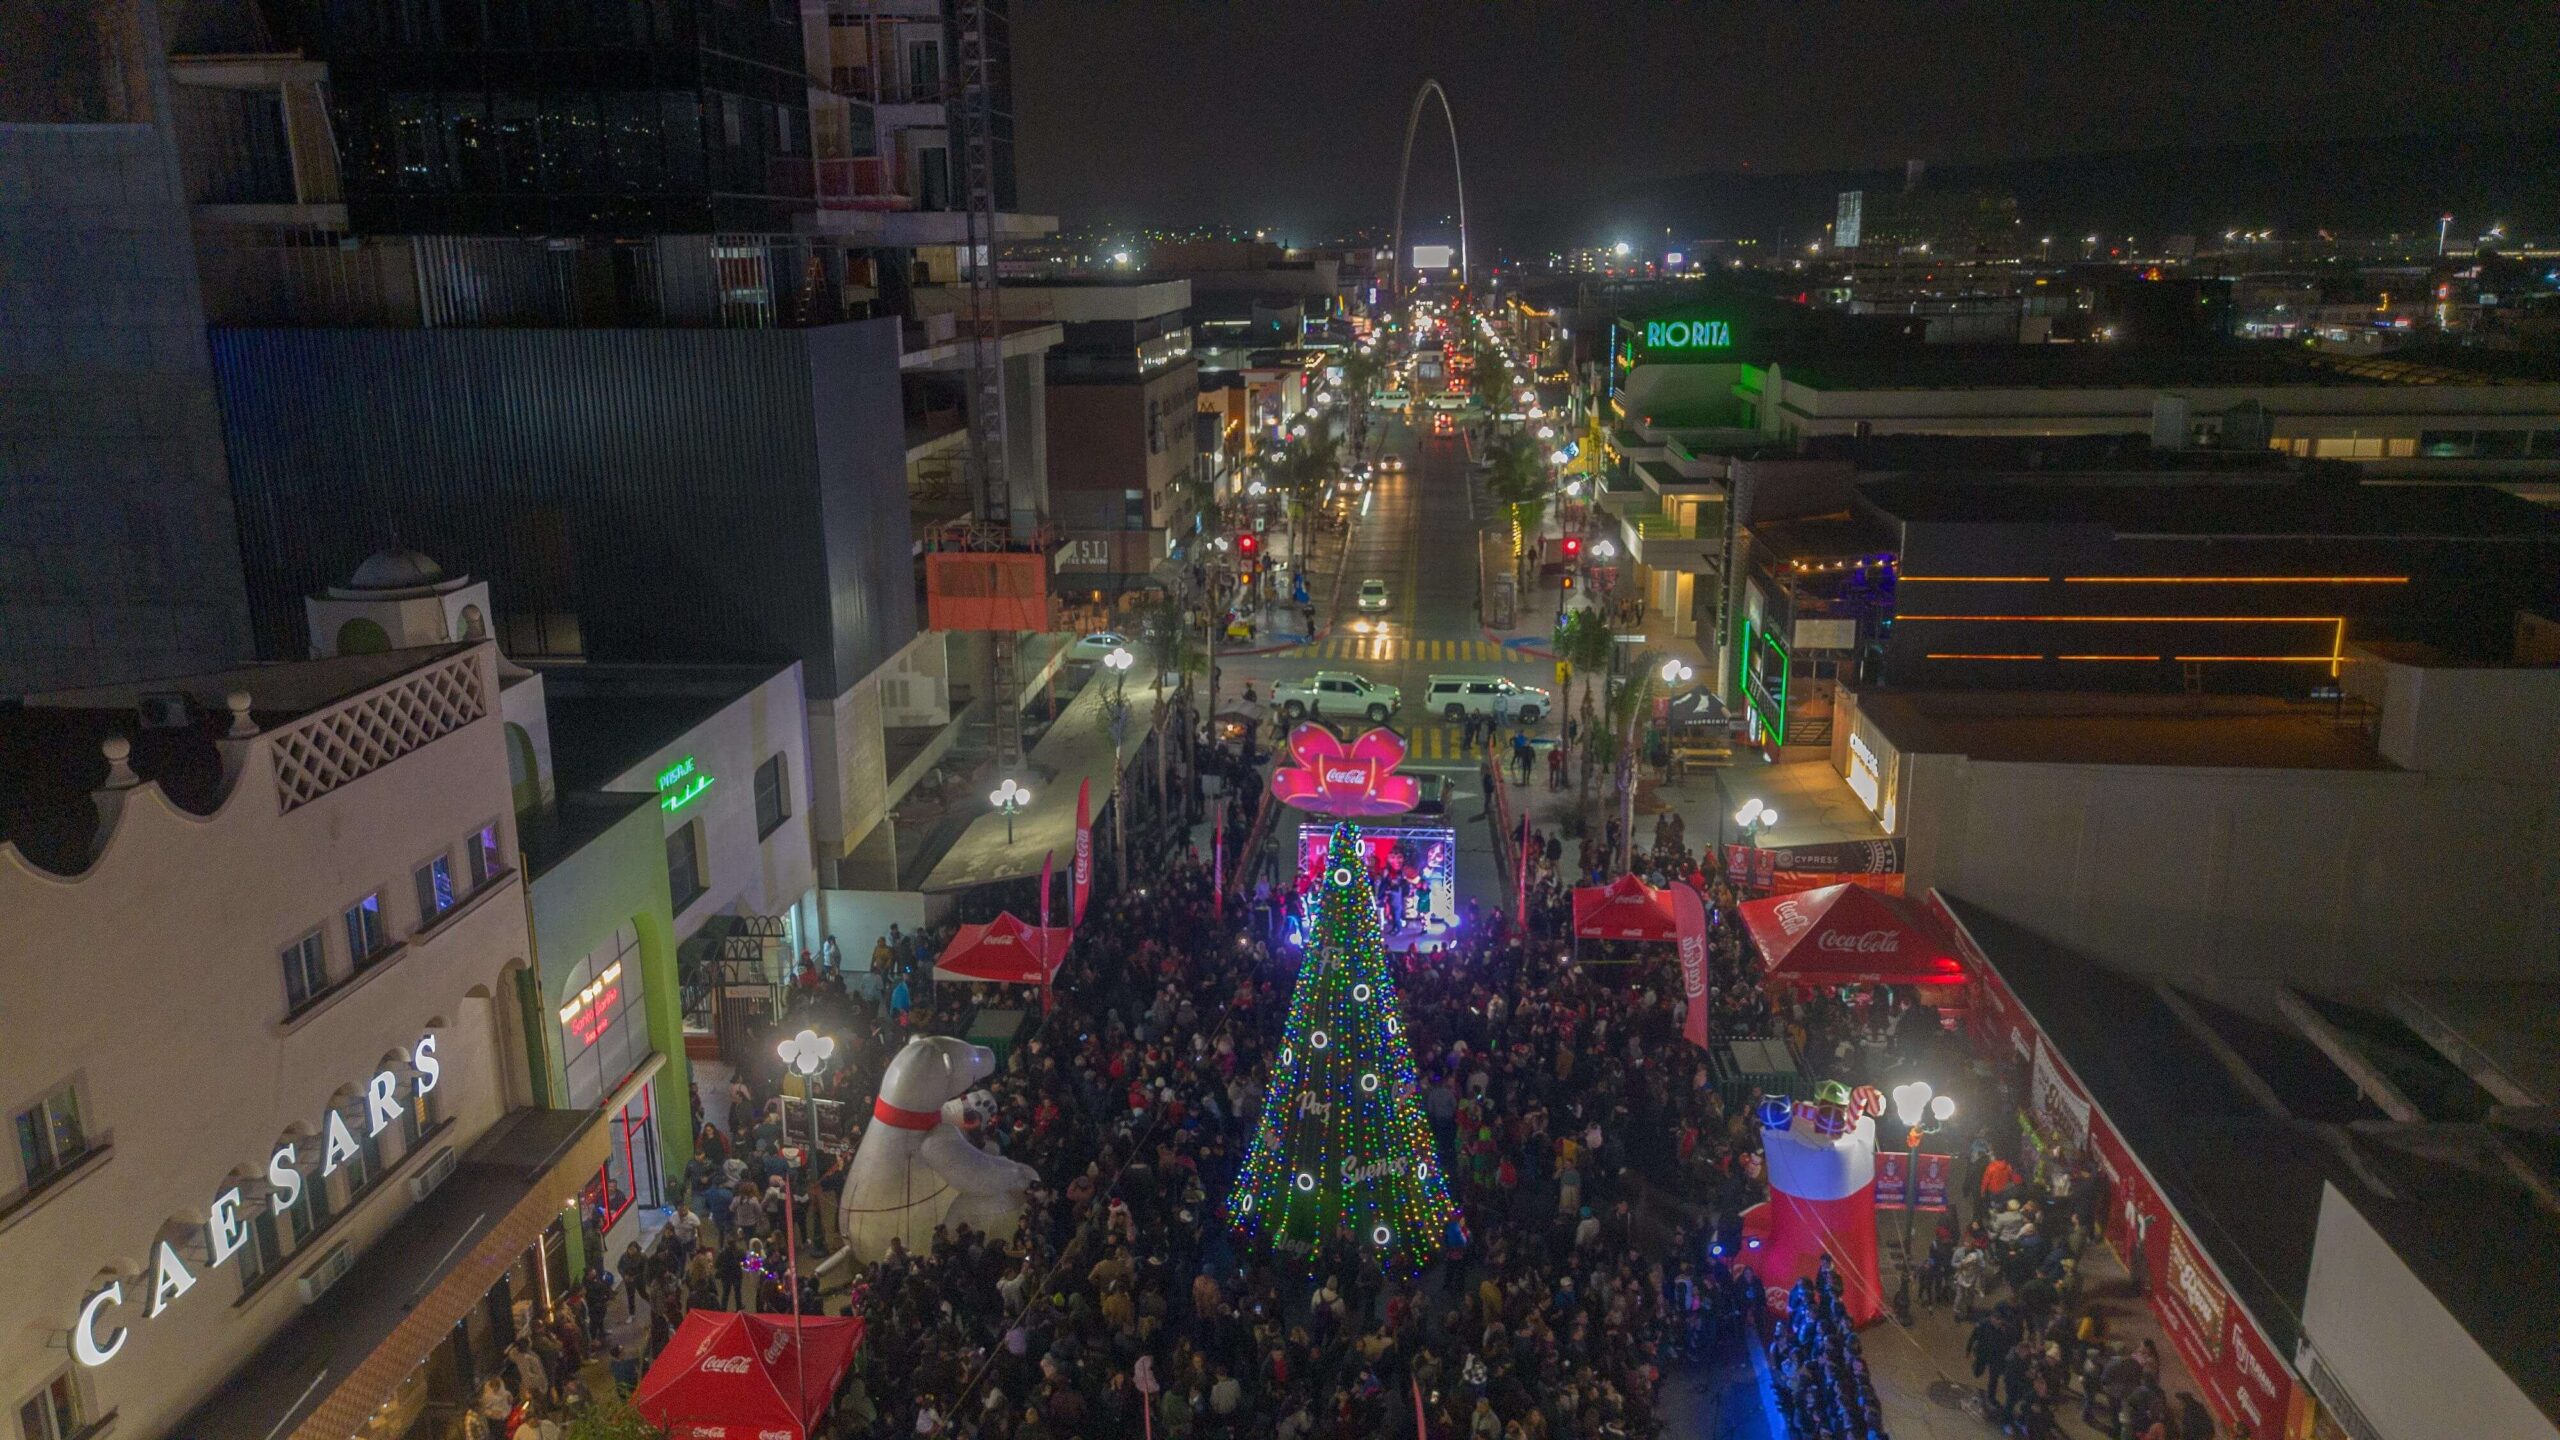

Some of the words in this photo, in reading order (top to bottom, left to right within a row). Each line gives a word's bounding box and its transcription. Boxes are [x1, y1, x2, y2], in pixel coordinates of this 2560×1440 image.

[1794, 855, 1839, 864] CYPRESS
[1817, 929, 1900, 953] Coca-Cola
[71, 1033, 440, 1367] CAESARS
[700, 1355, 751, 1374] Coca-Cola
